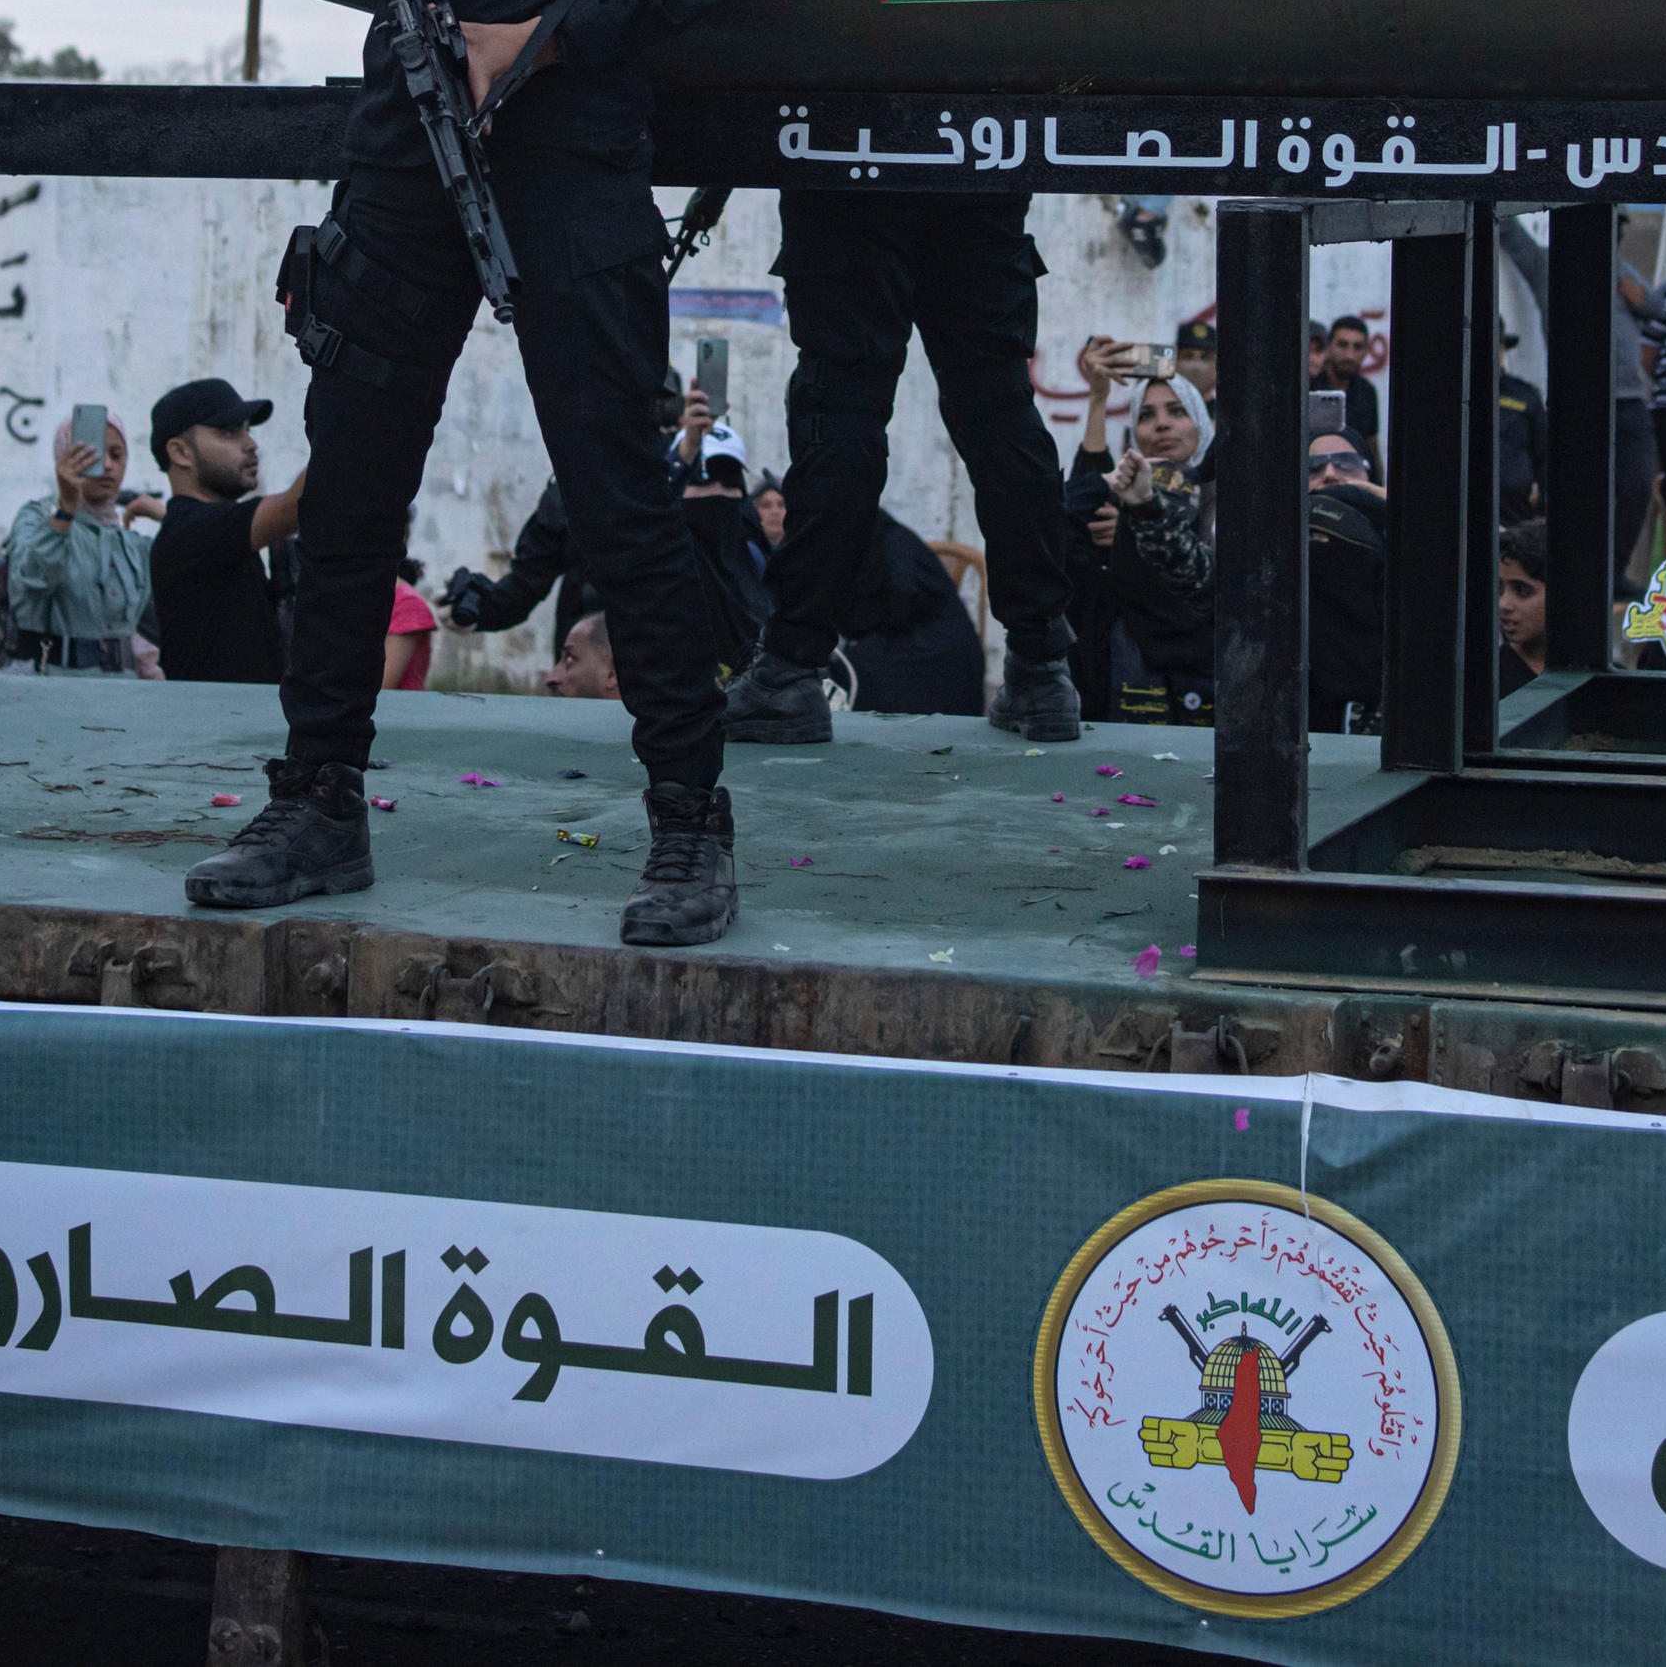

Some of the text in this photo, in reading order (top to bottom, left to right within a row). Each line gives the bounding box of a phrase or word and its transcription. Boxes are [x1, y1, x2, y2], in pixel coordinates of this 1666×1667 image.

[778, 104, 1259, 180] الصاروخية
[1277, 115, 1518, 188] القوة
[432, 1245, 875, 1403] القوة
[1248, 1296, 1303, 1336] الله
